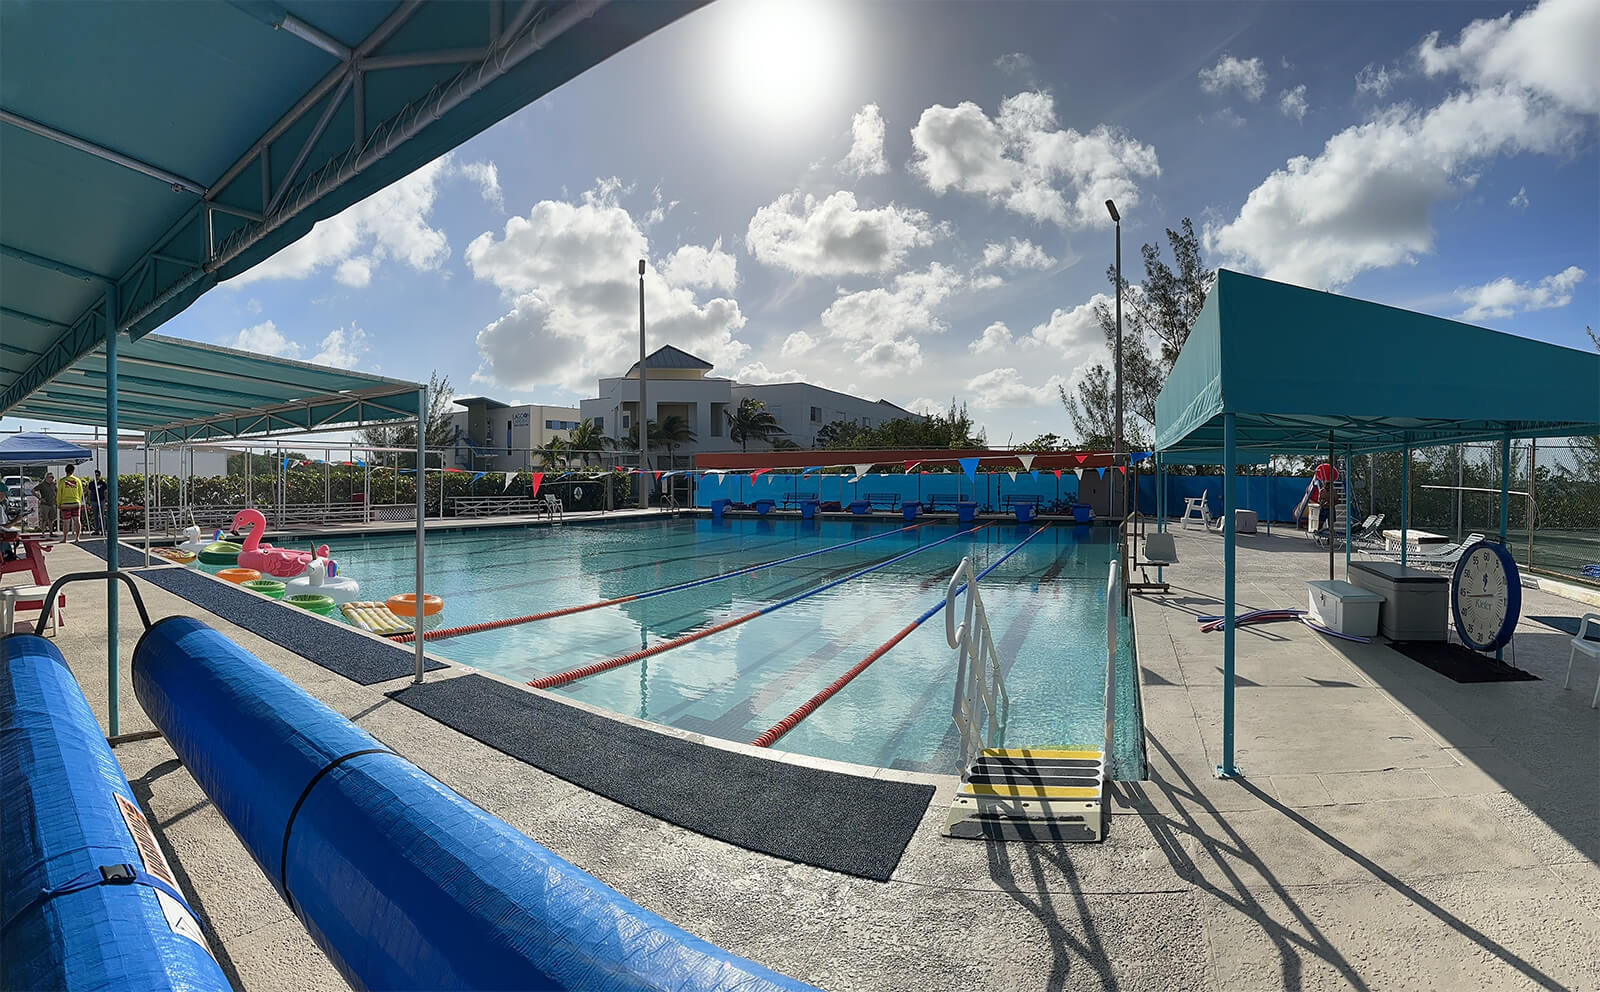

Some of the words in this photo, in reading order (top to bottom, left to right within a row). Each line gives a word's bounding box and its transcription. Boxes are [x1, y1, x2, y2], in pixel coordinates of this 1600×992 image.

[1472, 556, 1479, 565] 55
[1464, 569, 1471, 578] 50
[1467, 624, 1474, 634] 35
